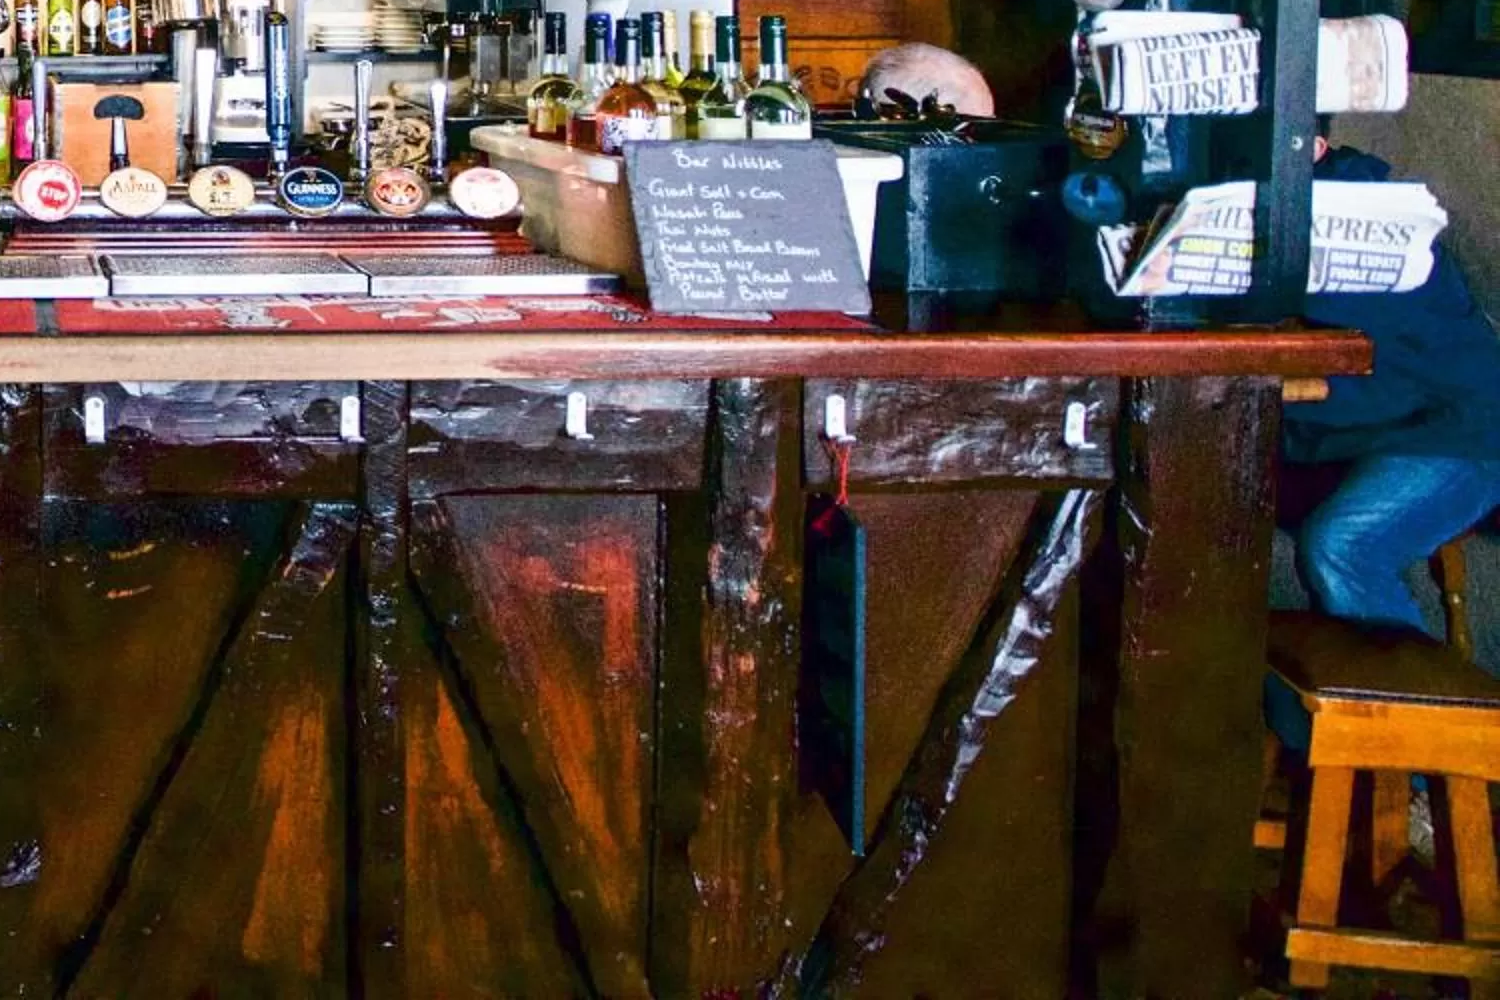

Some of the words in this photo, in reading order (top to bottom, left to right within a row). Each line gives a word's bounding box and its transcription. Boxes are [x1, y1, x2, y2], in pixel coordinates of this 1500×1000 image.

[1146, 47, 1213, 86] LEFT
[1146, 77, 1235, 114] NURSE
[287, 182, 338, 196] GUINNESS
[1312, 214, 1416, 248] XPRESS
